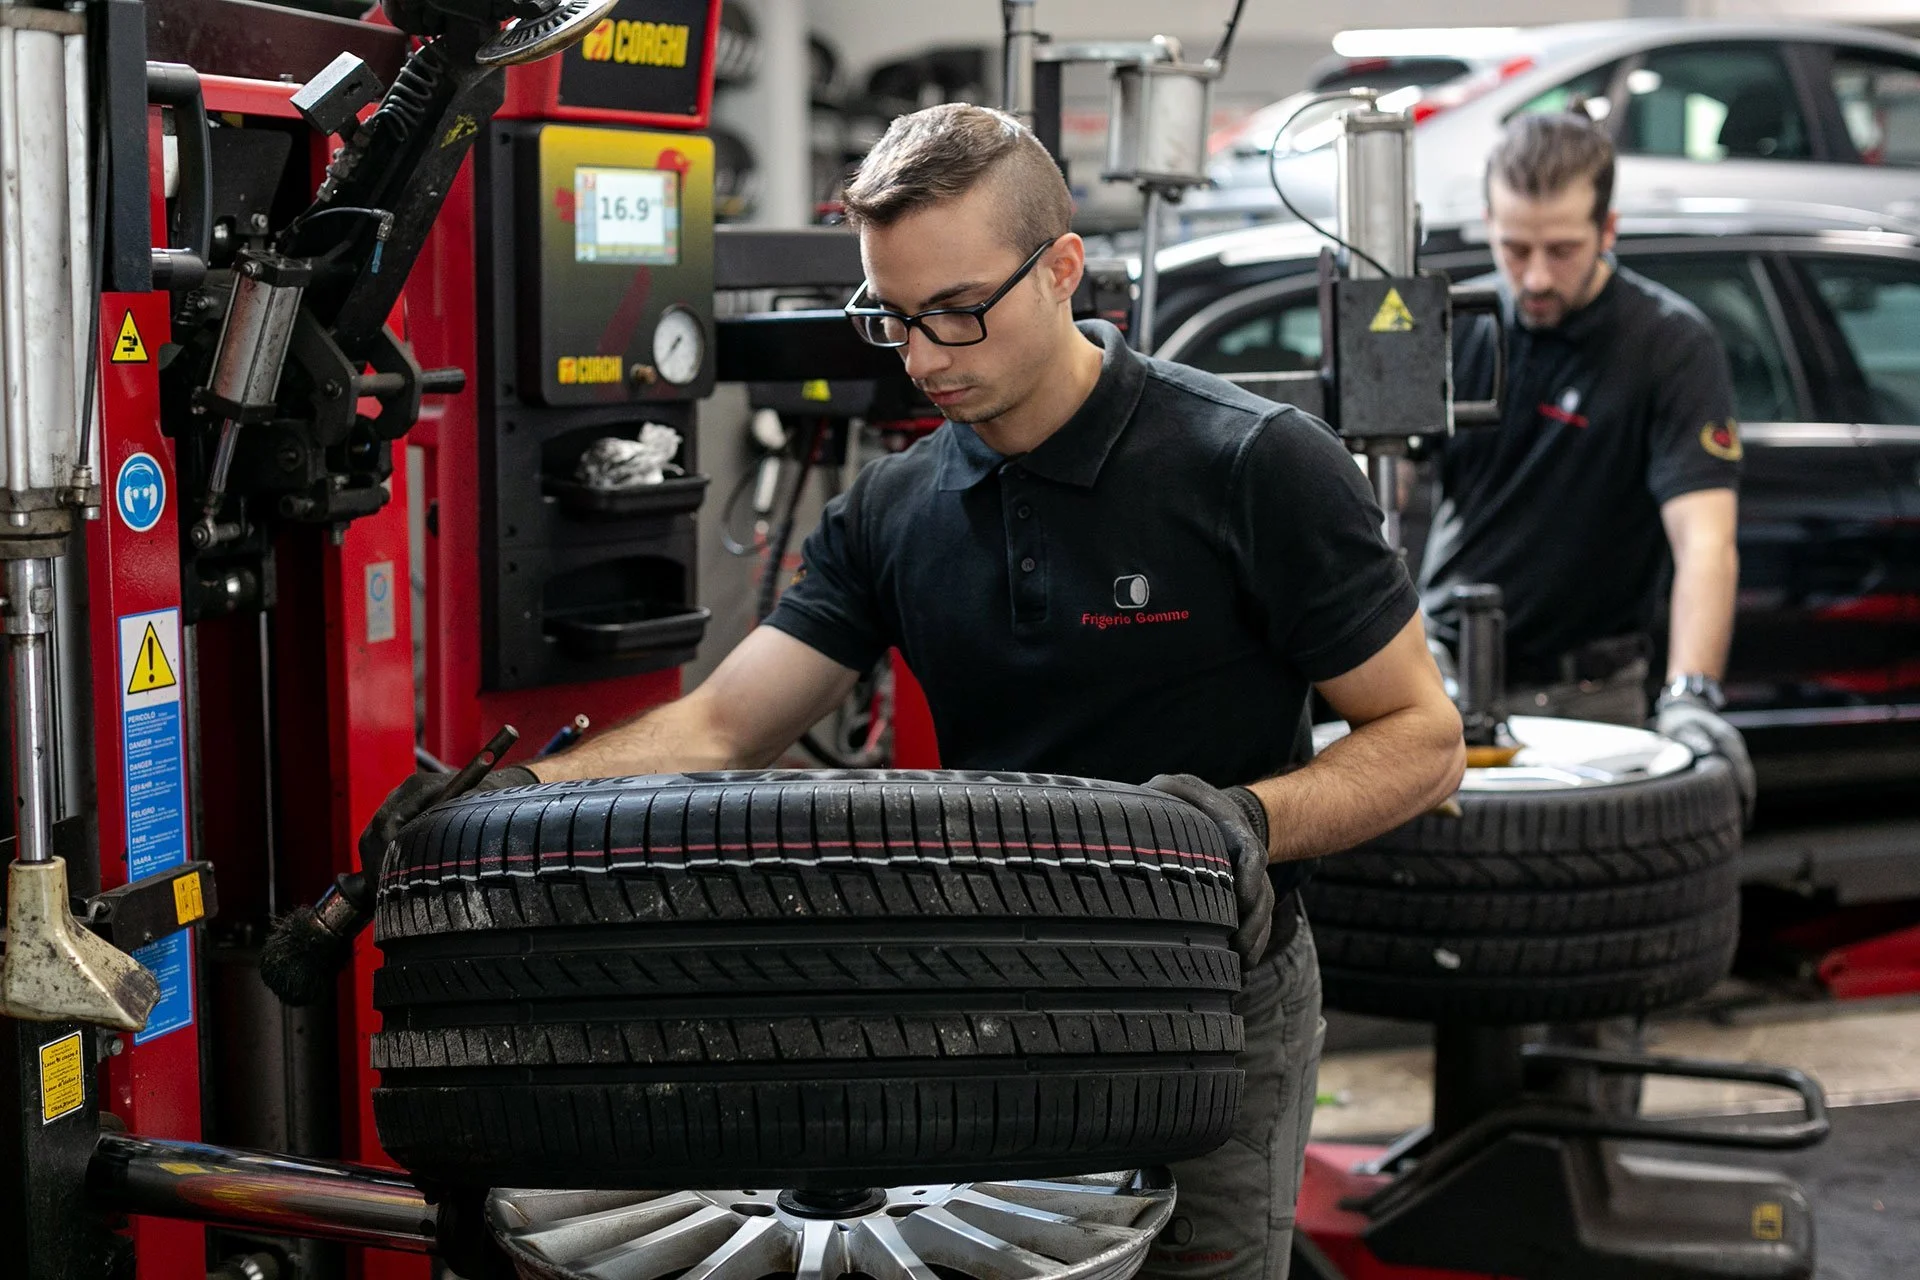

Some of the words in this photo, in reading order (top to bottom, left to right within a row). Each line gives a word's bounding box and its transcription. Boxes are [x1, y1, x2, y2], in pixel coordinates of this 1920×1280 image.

[614, 19, 689, 67] CORGHI
[601, 196, 650, 221] 16.9
[1082, 612, 1131, 630] Frigerio
[1135, 610, 1190, 624] Gomme
[128, 711, 156, 723] PERICOLO
[129, 738, 152, 750] DANGER
[130, 760, 153, 771] DANGER
[131, 806, 156, 819] PELIGRO
